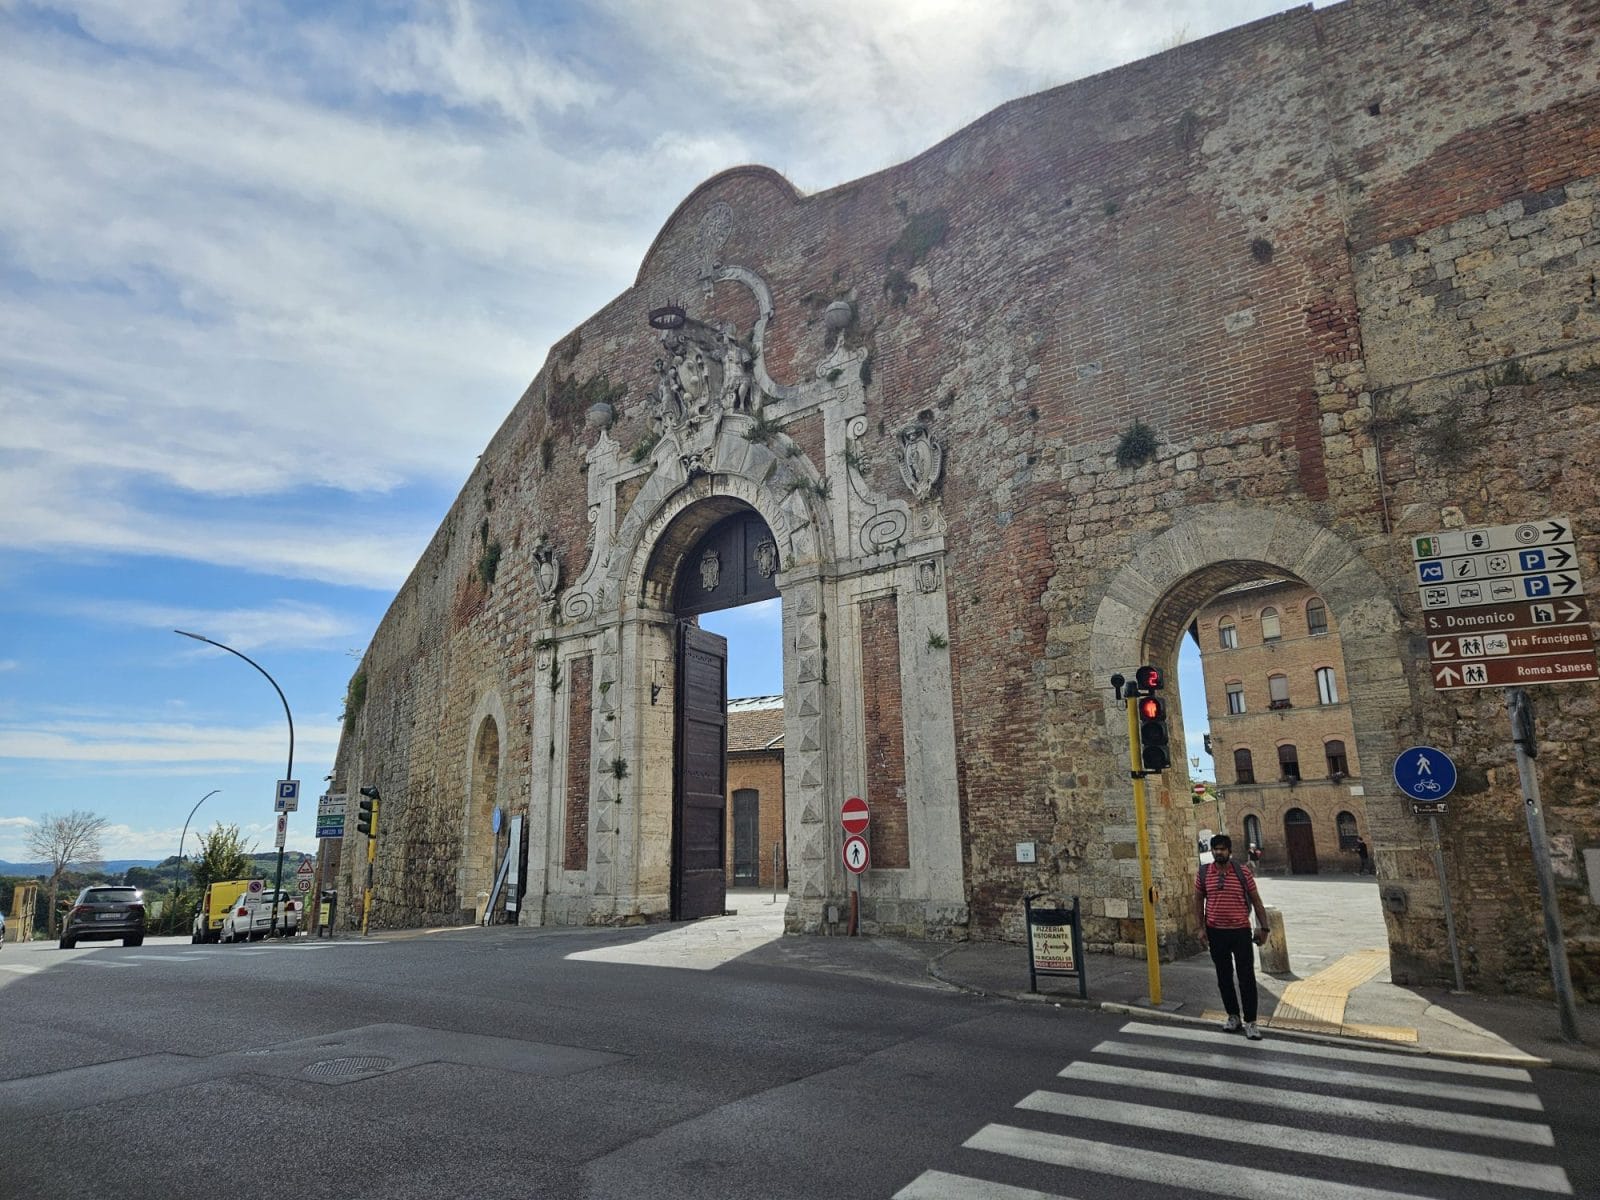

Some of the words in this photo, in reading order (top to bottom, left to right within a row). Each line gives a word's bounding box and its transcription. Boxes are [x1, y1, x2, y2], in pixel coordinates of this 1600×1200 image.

[1526, 554, 1540, 569] P
[1530, 580, 1544, 595] P
[1429, 616, 1441, 629] S.
[1446, 612, 1516, 627] Domenico
[1511, 636, 1528, 647] via
[1532, 633, 1588, 645] Francigena
[1518, 664, 1553, 676] Romea
[1554, 662, 1593, 674] Sanese
[1148, 671, 1158, 686] 2
[282, 784, 293, 797] P
